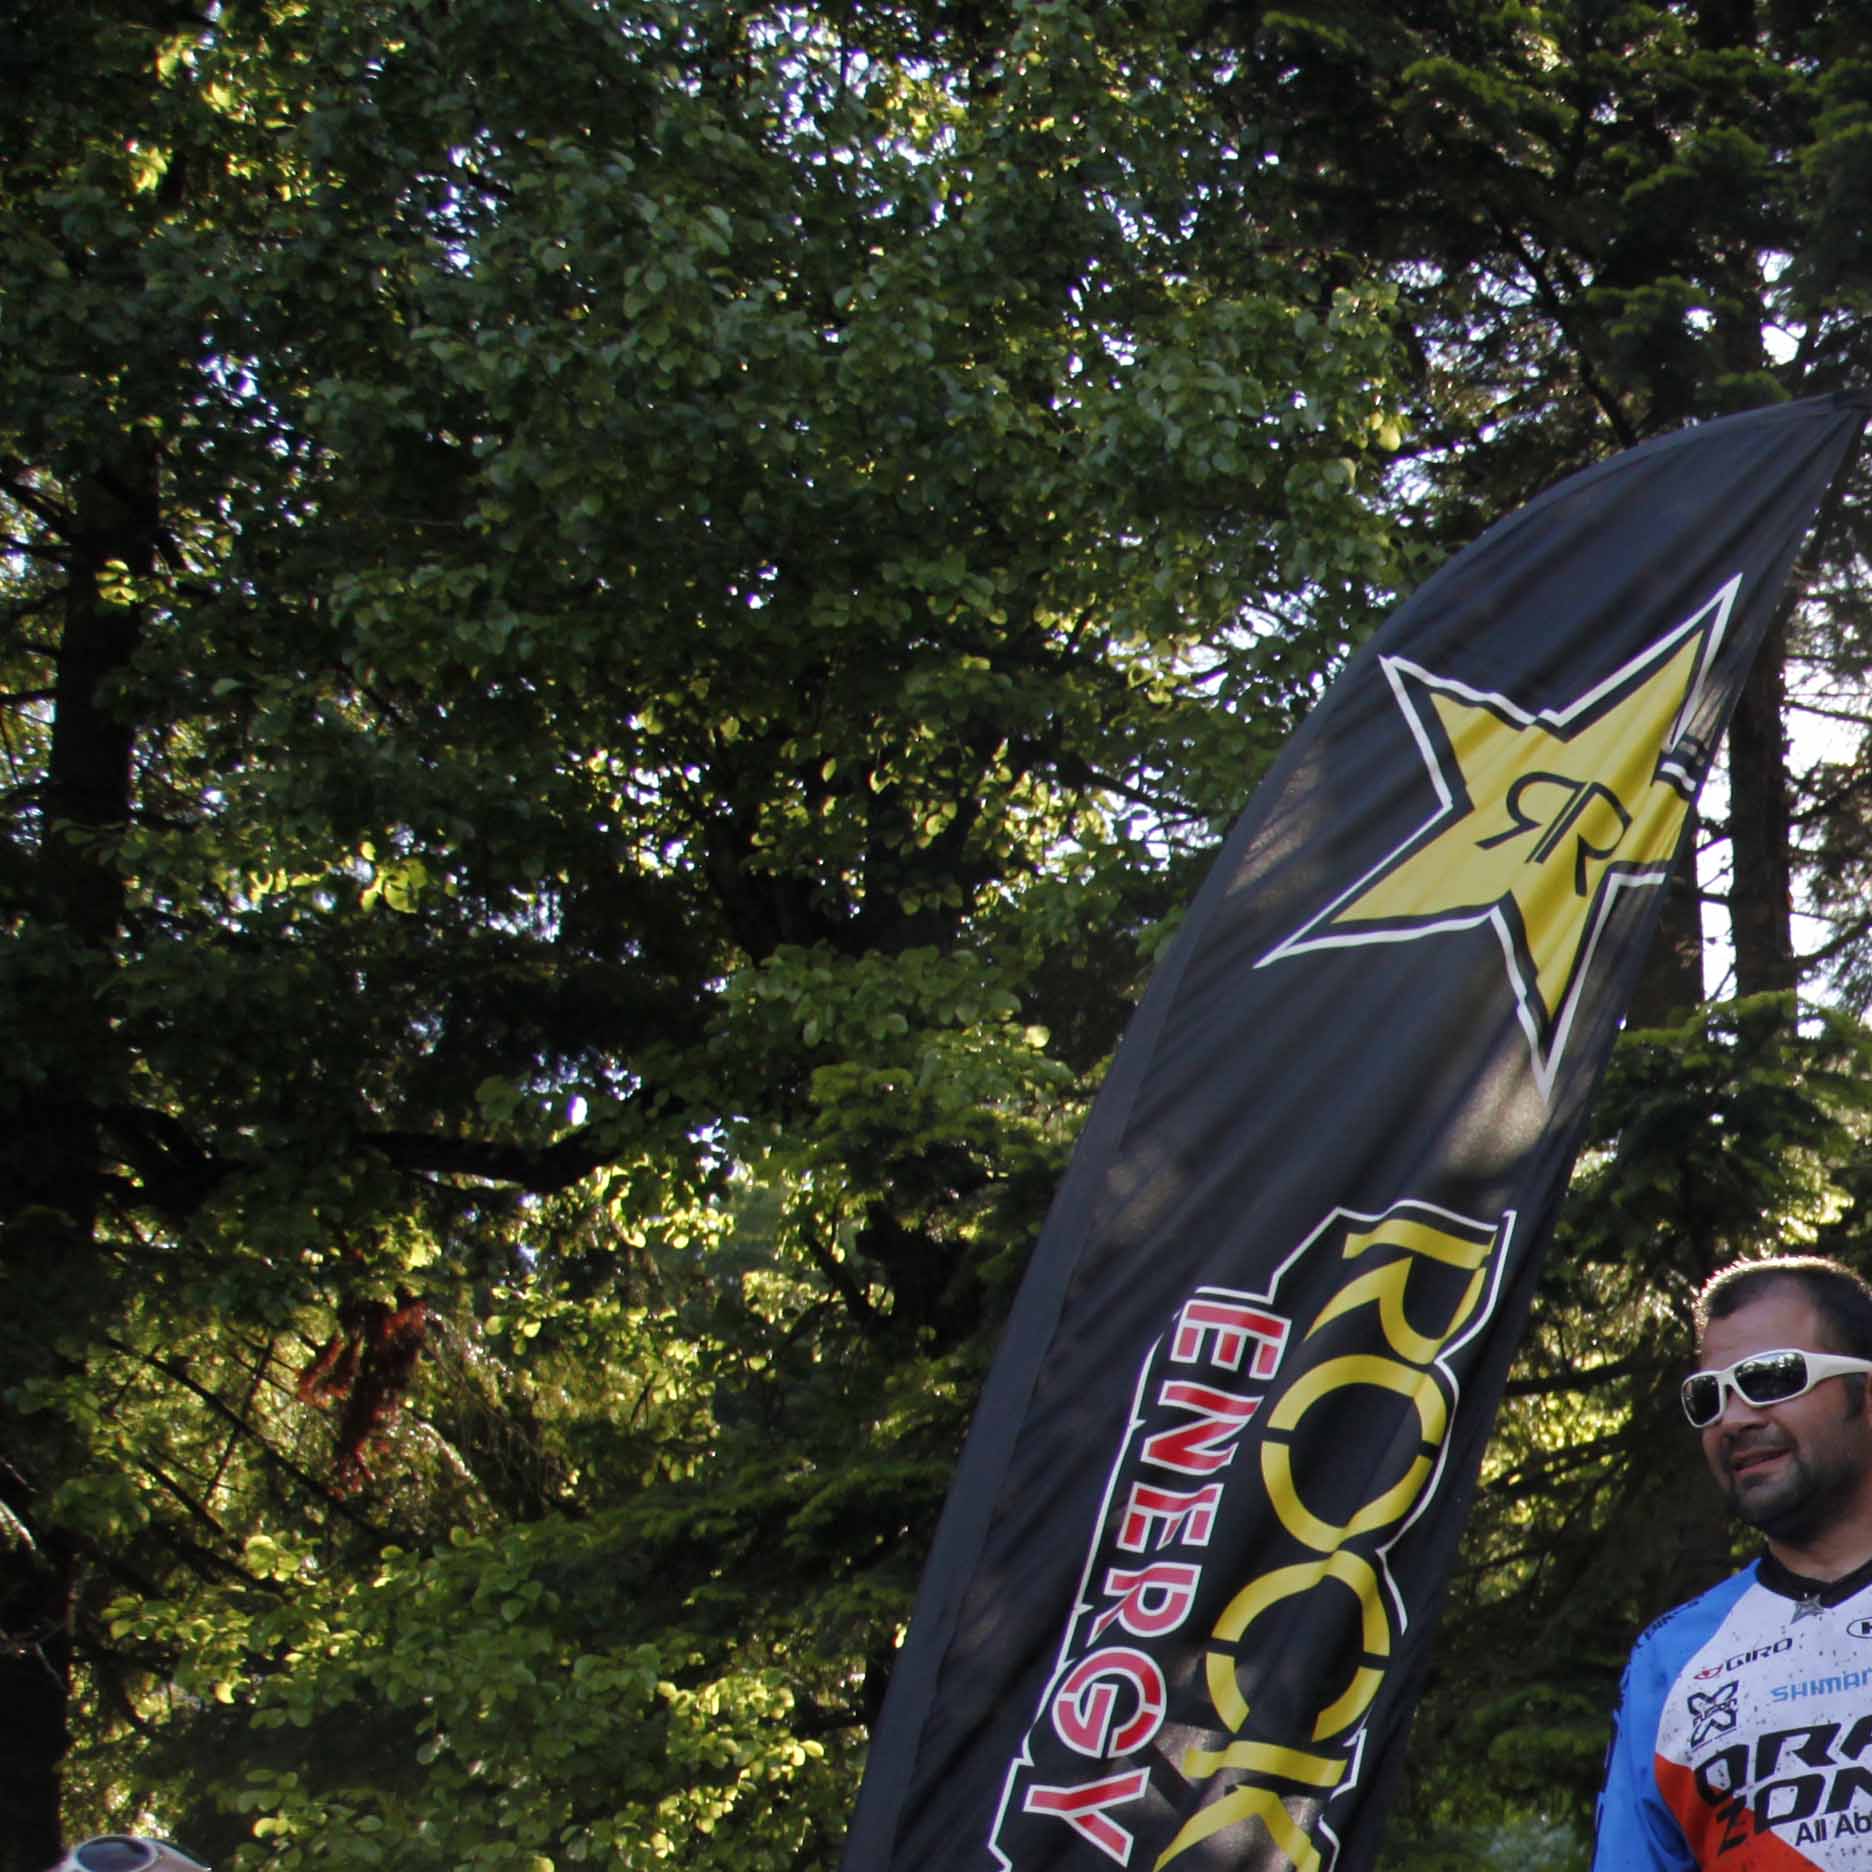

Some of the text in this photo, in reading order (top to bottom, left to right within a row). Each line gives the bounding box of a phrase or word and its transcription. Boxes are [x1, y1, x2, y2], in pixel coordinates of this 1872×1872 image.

[1020, 1293, 1291, 1870] ENERGY
[1725, 1637, 1793, 1672] GIRO
[1796, 1817, 1827, 1848] All
